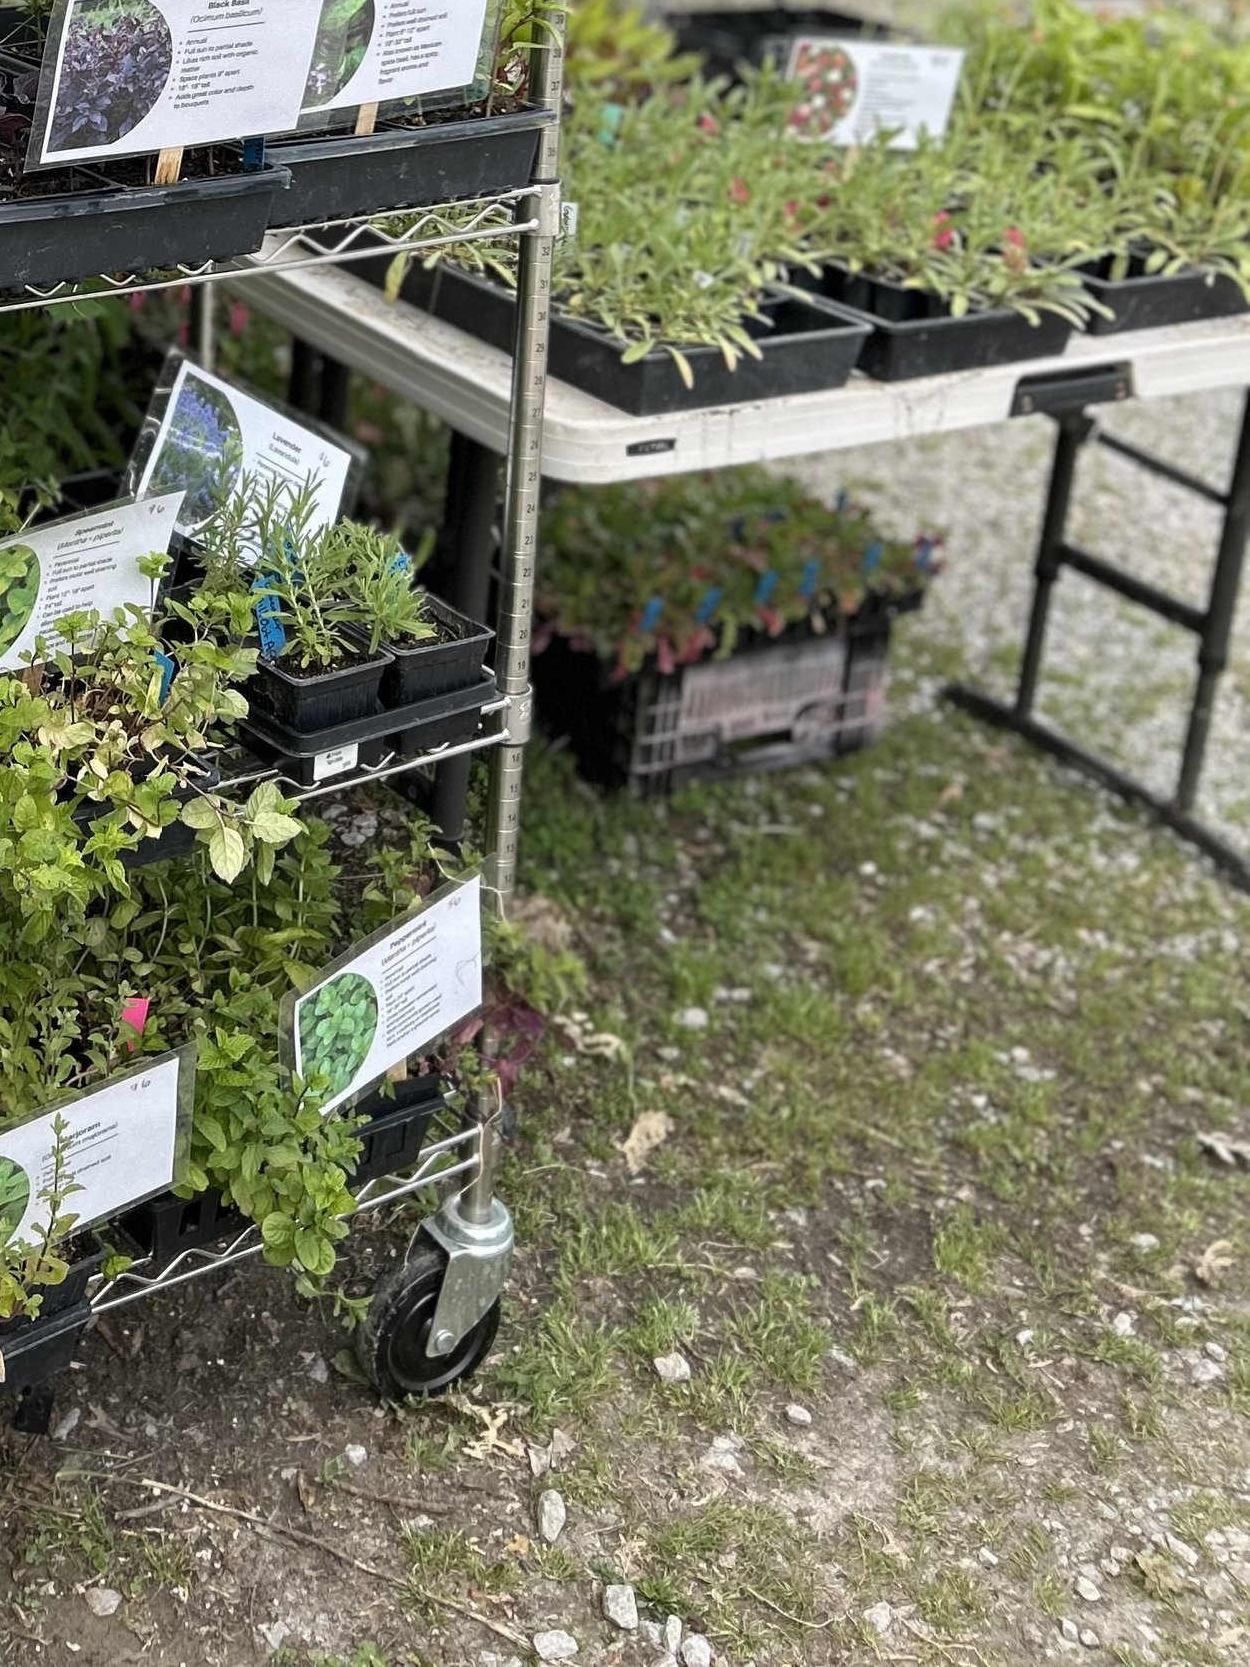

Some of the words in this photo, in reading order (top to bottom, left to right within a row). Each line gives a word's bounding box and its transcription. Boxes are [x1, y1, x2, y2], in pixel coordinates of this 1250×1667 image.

[207, 0, 229, 9] Black
[189, 13, 224, 24] (Ocimum
[224, 7, 263, 19] basilicum)
[542, 246, 550, 256] 32
[540, 280, 548, 288] 31
[538, 312, 546, 321] 30
[536, 344, 544, 352] 29
[533, 408, 540, 417] 27
[272, 431, 301, 453] Lavender
[528, 472, 537, 482] 25
[527, 504, 535, 513] 24
[525, 536, 533, 545] 23
[523, 568, 531, 577] 22
[522, 599, 530, 608] 21
[519, 630, 528, 639] 20
[512, 753, 520, 763] 16
[510, 784, 518, 793] 15
[509, 814, 516, 823] 14
